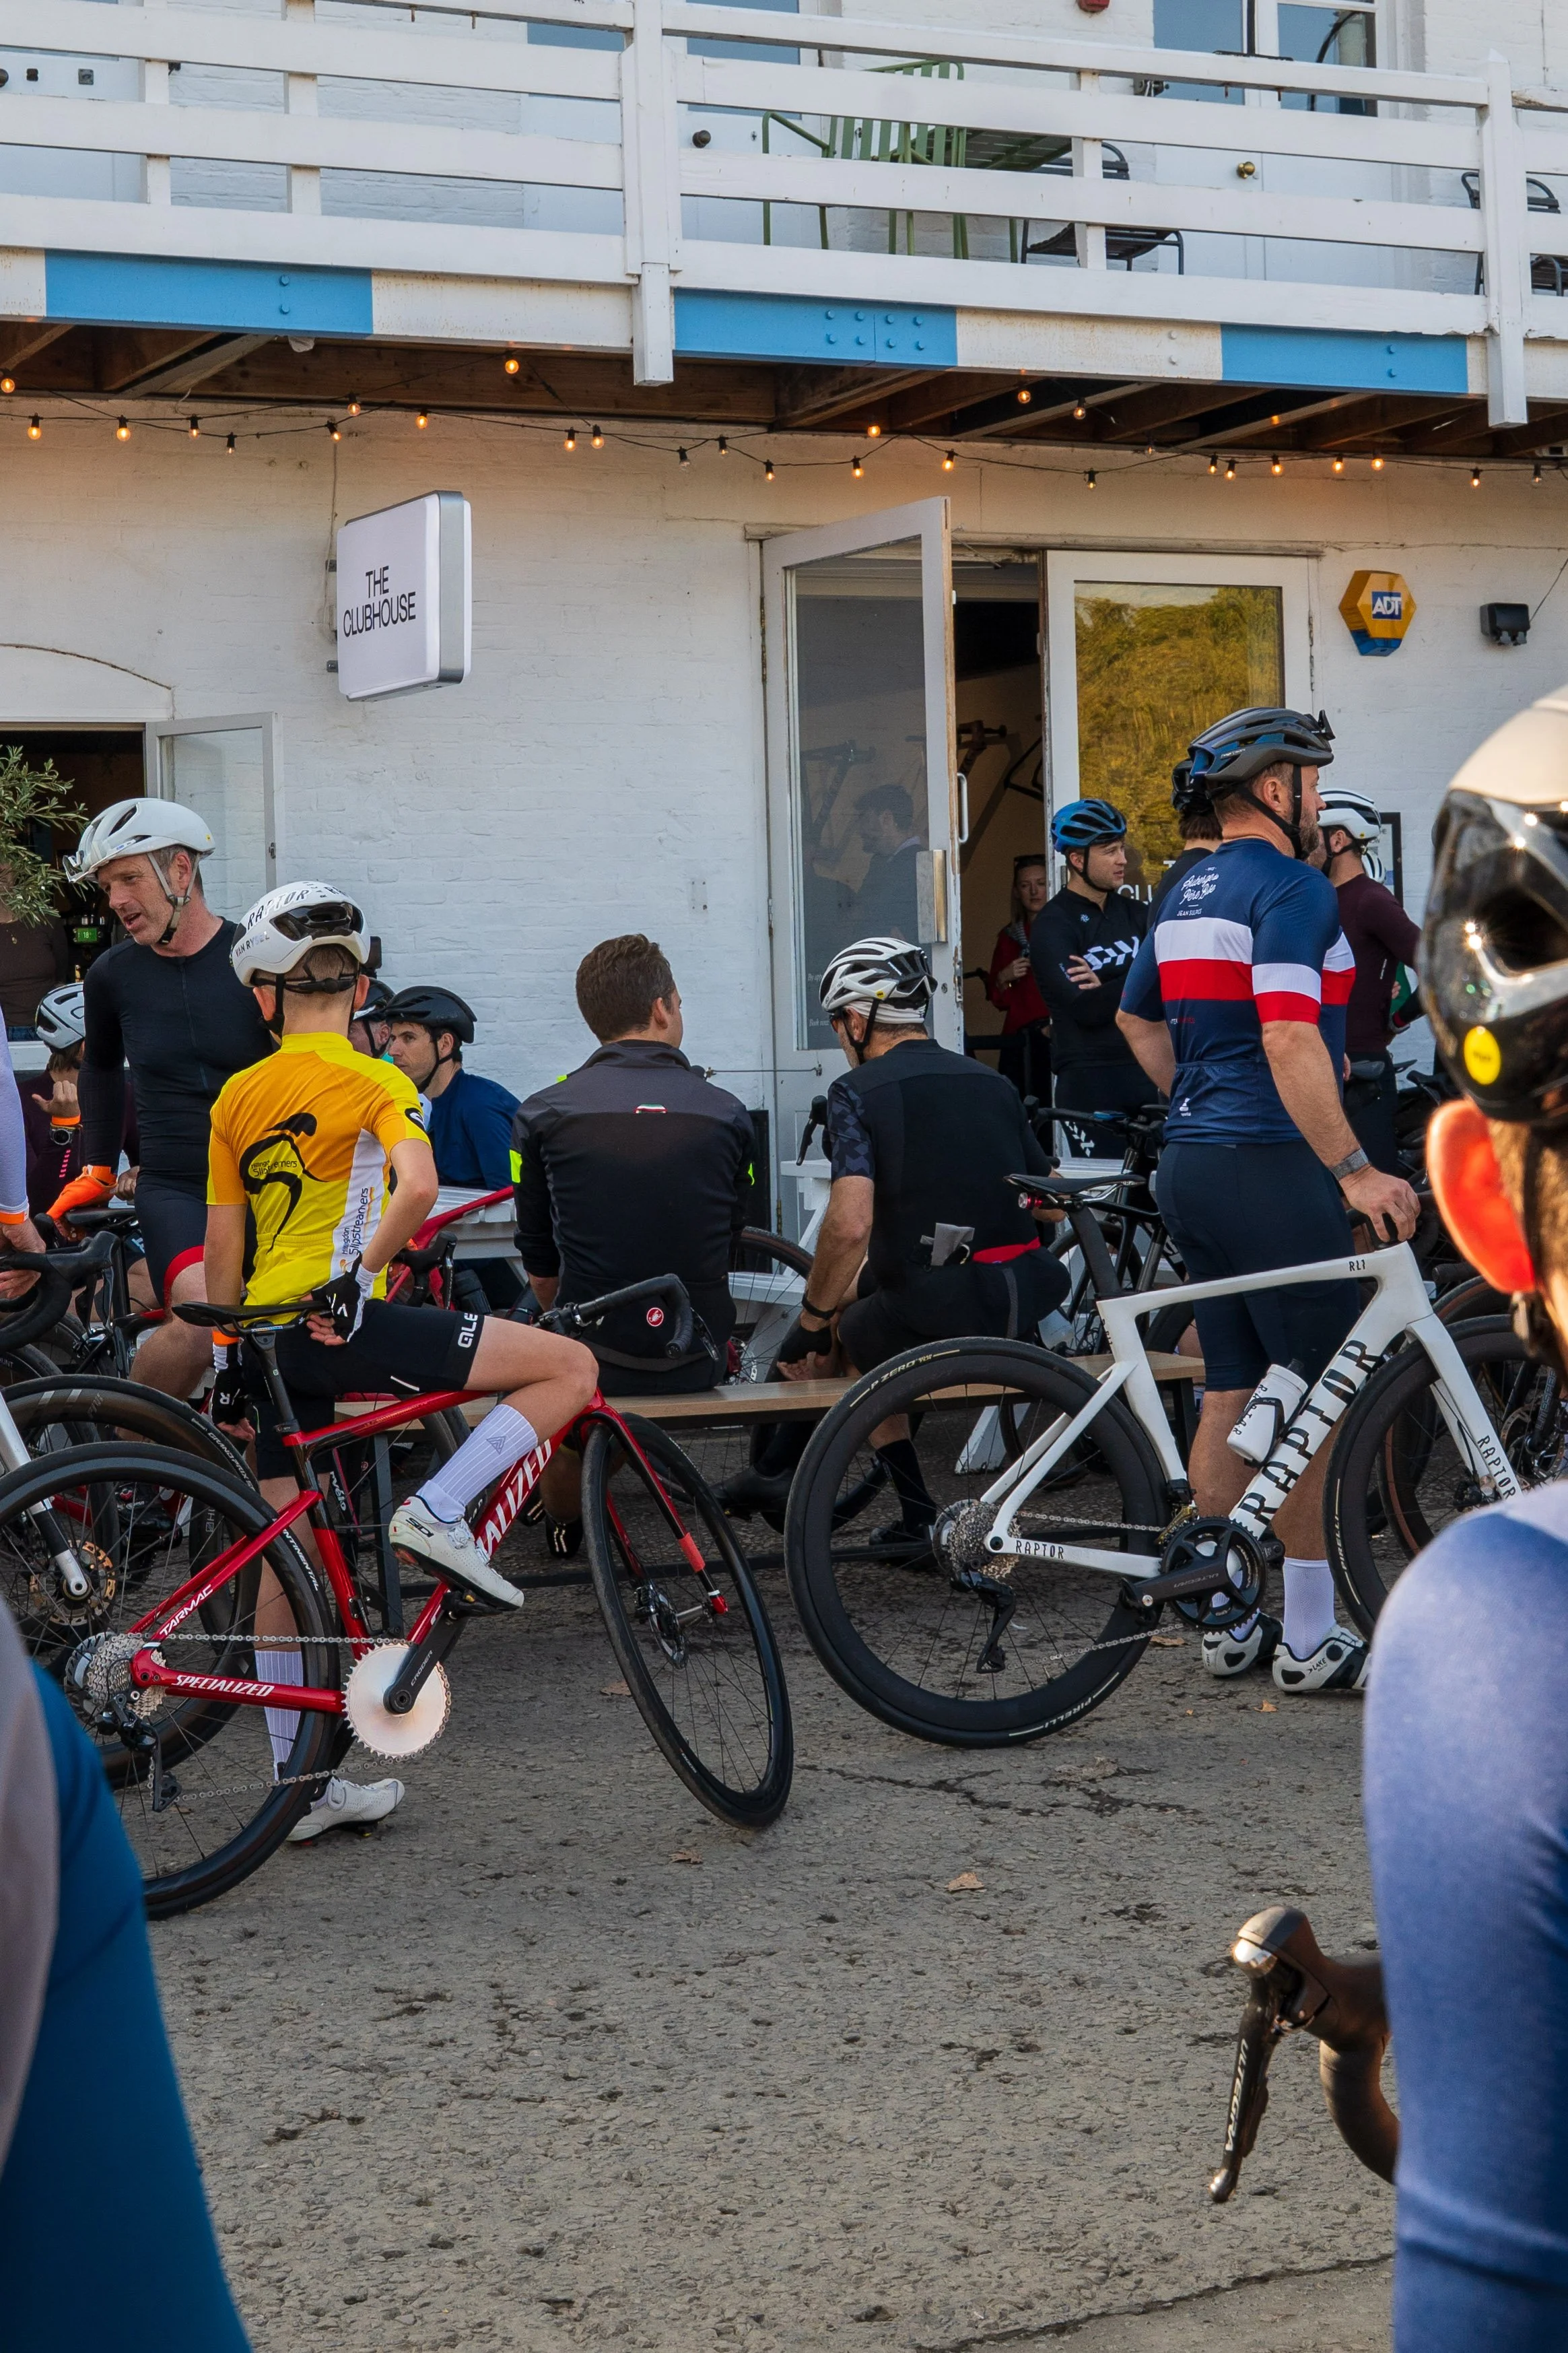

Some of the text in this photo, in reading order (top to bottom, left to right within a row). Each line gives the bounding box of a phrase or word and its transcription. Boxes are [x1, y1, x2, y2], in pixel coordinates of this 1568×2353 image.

[365, 565, 389, 599] THE
[343, 591, 416, 638] CLUBHOUSE
[1372, 596, 1402, 616] ADT
[247, 889, 310, 931] RAPTOR
[235, 943, 245, 958] VAN
[349, 1187, 368, 1256] Slipstreamers
[1349, 1259, 1365, 1271] RL1
[881, 1360, 916, 1383] ZERO
[207, 1432, 234, 1459] GRAND
[1237, 1339, 1382, 1527] RAPTOR
[1477, 1435, 1516, 1499] RAPTOR
[1015, 1538, 1064, 1560] RAPTOR
[1334, 1516, 1347, 1570] PIRELLI
[159, 1584, 213, 1636] TARMAC
[411, 1650, 433, 1687] CRODER
[1312, 1657, 1327, 1671] LAKE
[171, 1674, 275, 1697] SPECIALIZED
[1044, 1696, 1091, 1729] PIRELLI
[1225, 2038, 1249, 2152] ULTEGRA
